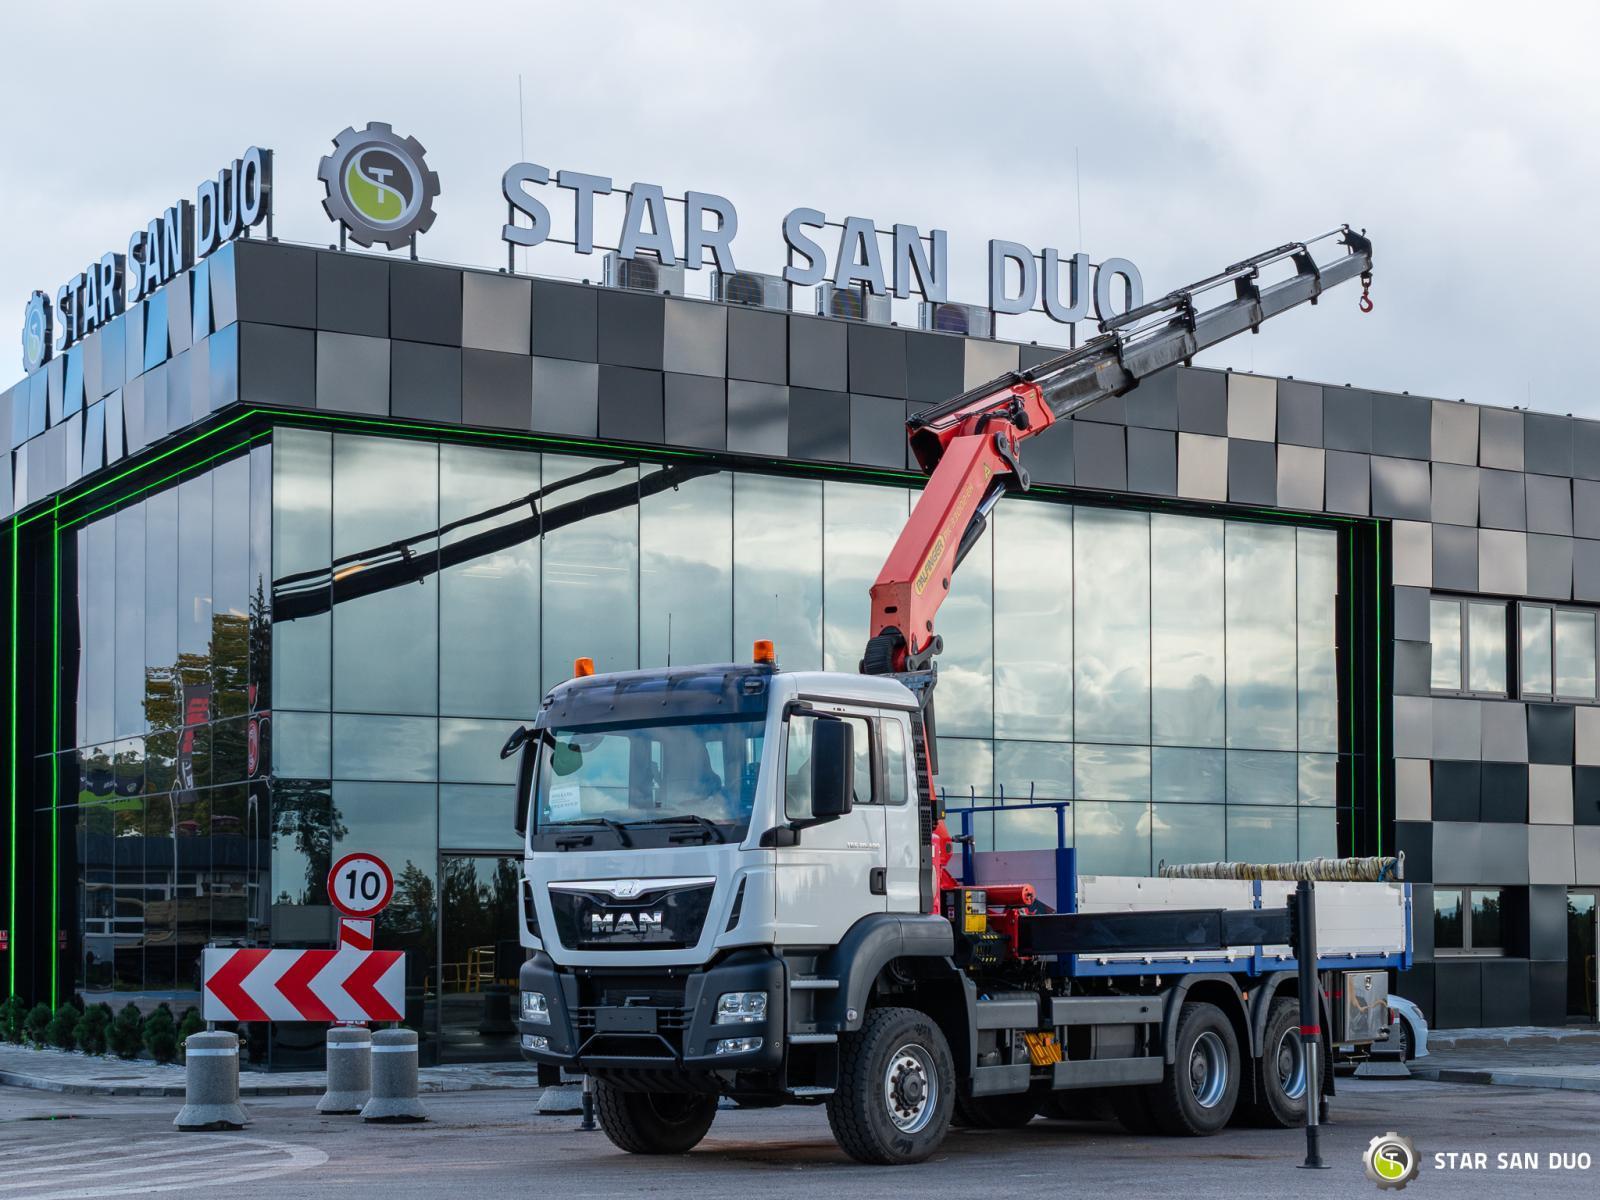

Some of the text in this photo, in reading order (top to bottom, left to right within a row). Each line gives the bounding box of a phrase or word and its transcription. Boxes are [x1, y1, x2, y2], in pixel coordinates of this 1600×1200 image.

[56, 146, 266, 351] STAR SAN DUO
[502, 162, 1143, 331] STAR SAN DUO
[916, 538, 944, 591] PALFINGER
[346, 869, 380, 901] 10
[591, 912, 662, 933] MAN
